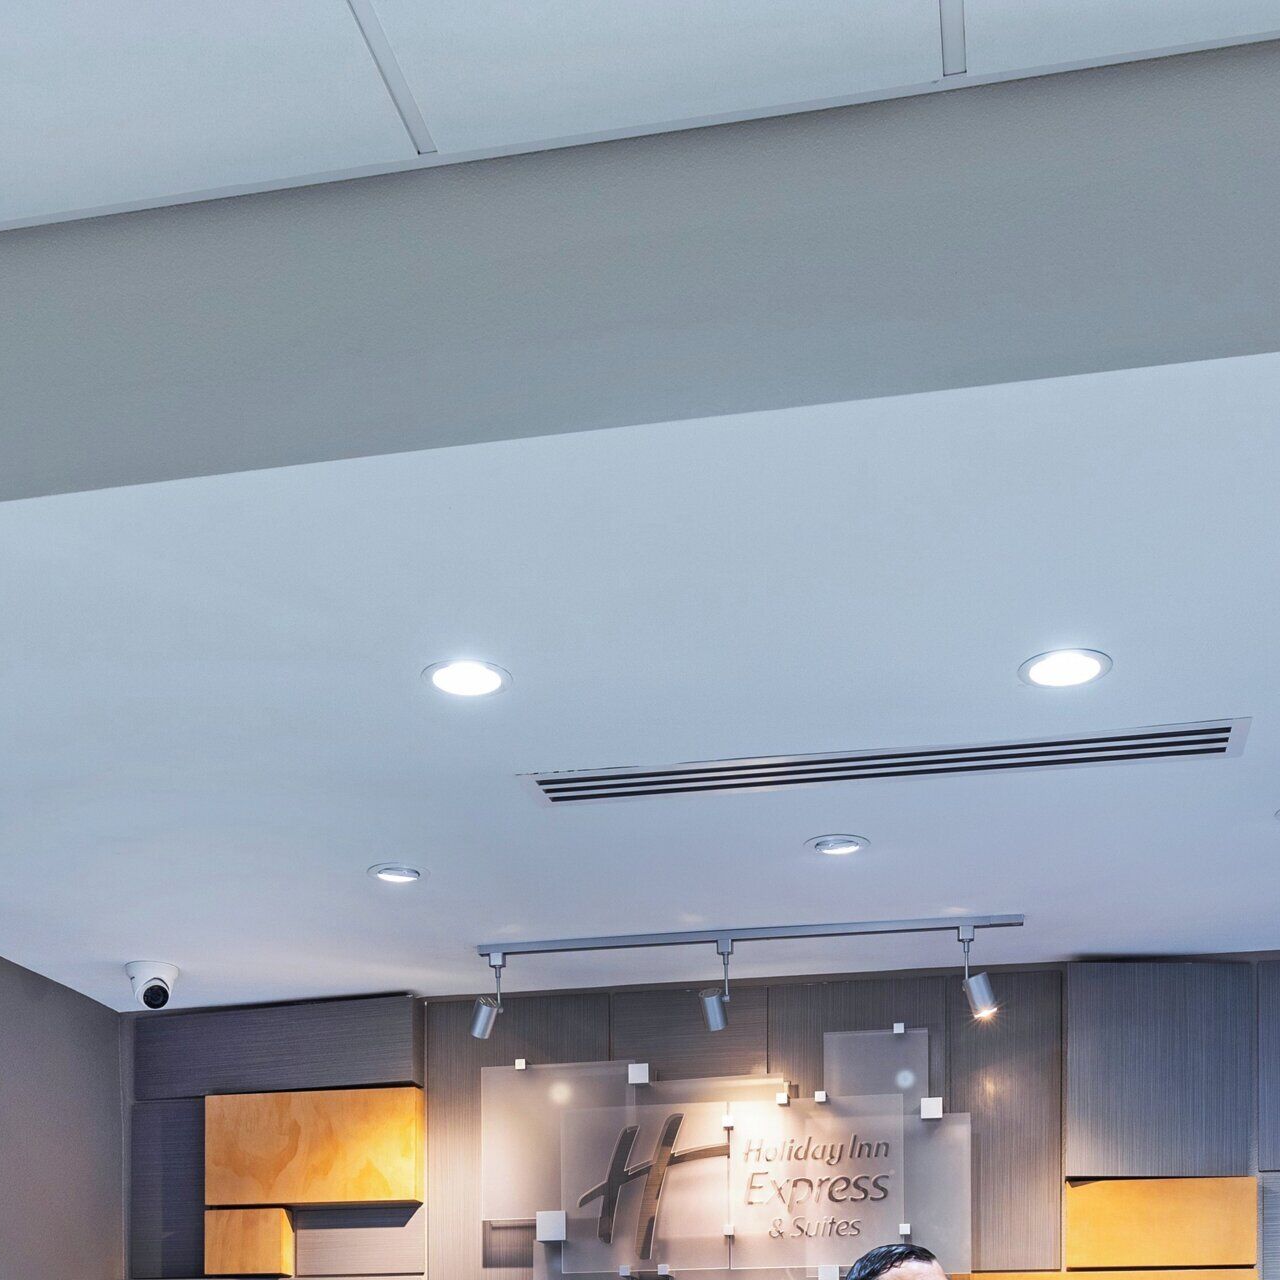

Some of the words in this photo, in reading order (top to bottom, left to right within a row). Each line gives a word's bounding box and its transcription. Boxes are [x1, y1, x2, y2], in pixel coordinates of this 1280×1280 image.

[744, 1136, 844, 1166] Holiday
[849, 1133, 890, 1158] Inn
[744, 1172, 890, 1214] Express
[769, 1218, 785, 1240] &
[790, 1216, 862, 1238] Suites
